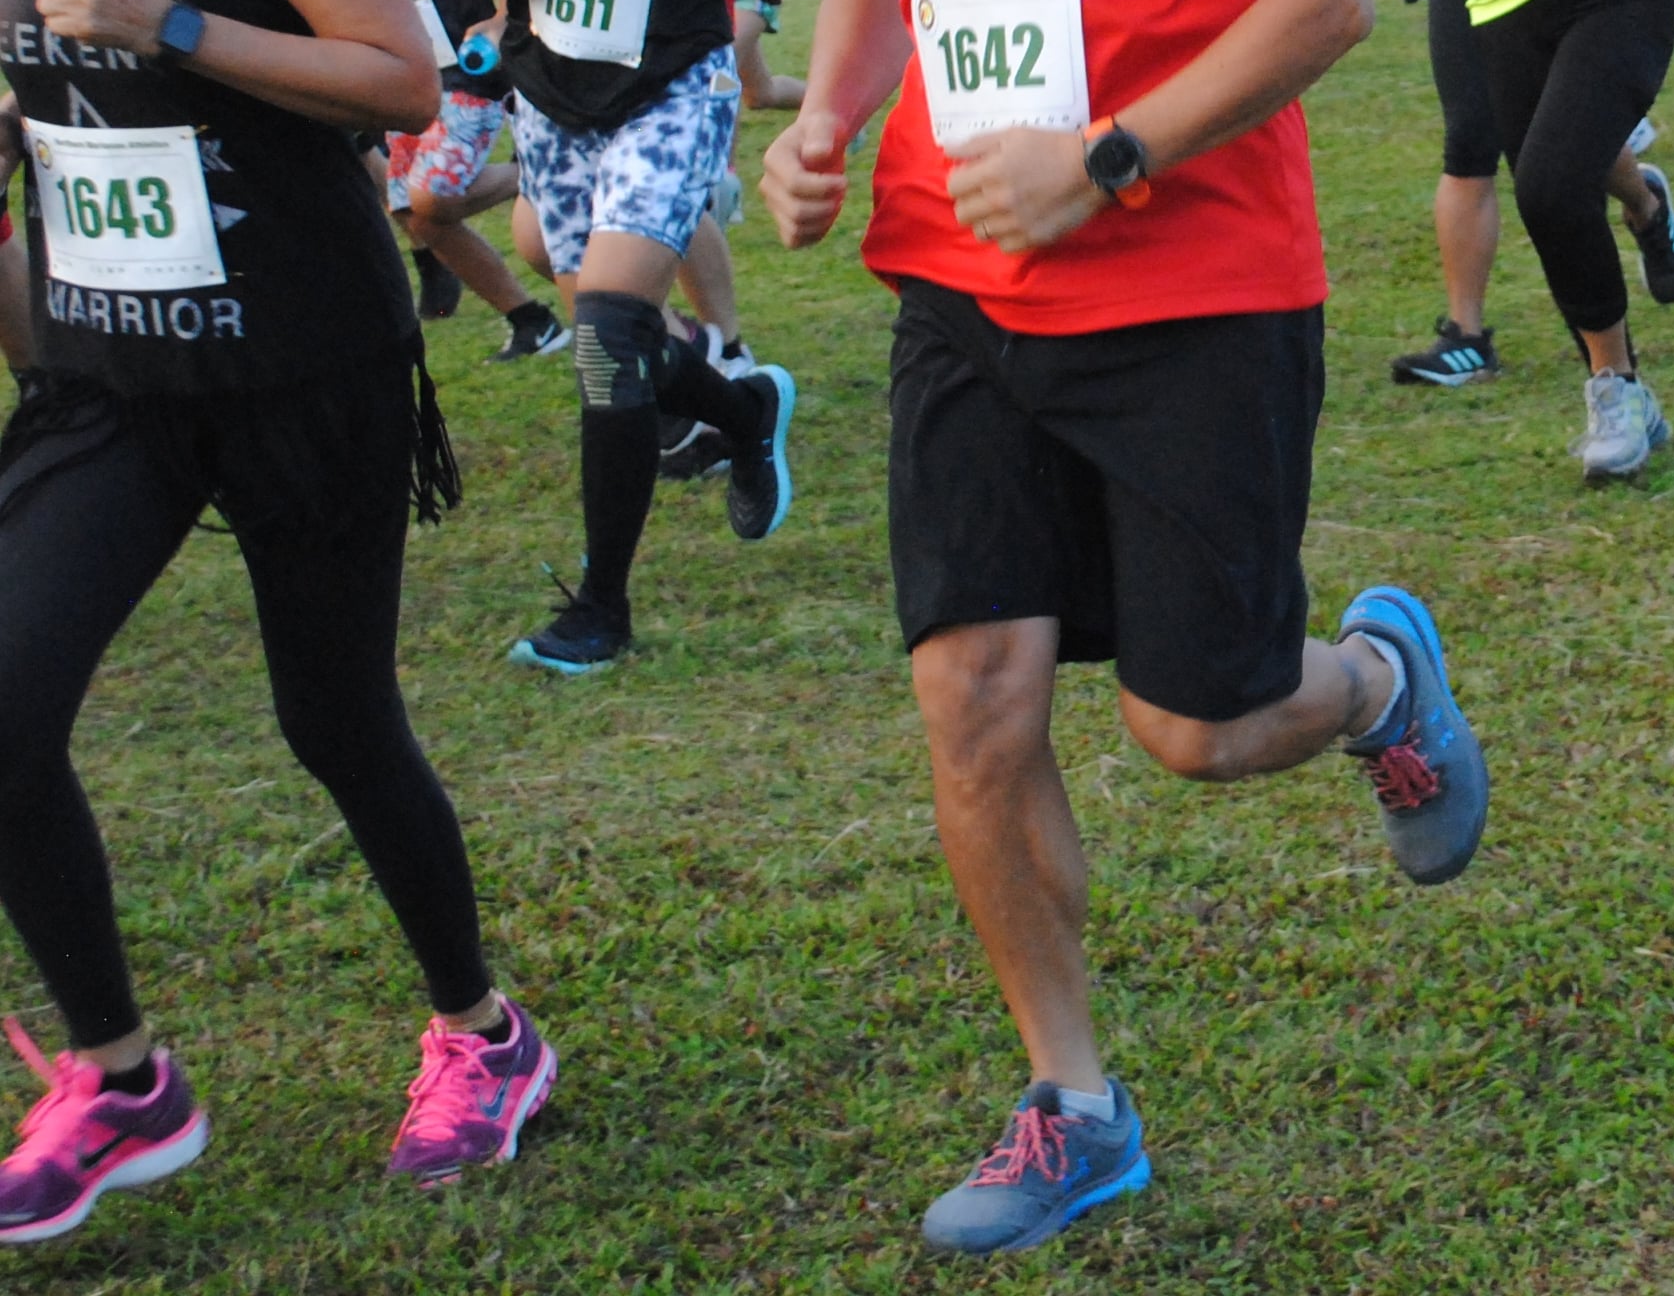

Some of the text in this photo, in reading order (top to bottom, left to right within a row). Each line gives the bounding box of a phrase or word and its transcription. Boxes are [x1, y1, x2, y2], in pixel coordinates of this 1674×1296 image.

[938, 22, 1046, 93] 1642
[56, 176, 176, 239] 1643
[46, 278, 246, 340] WARRIOR
